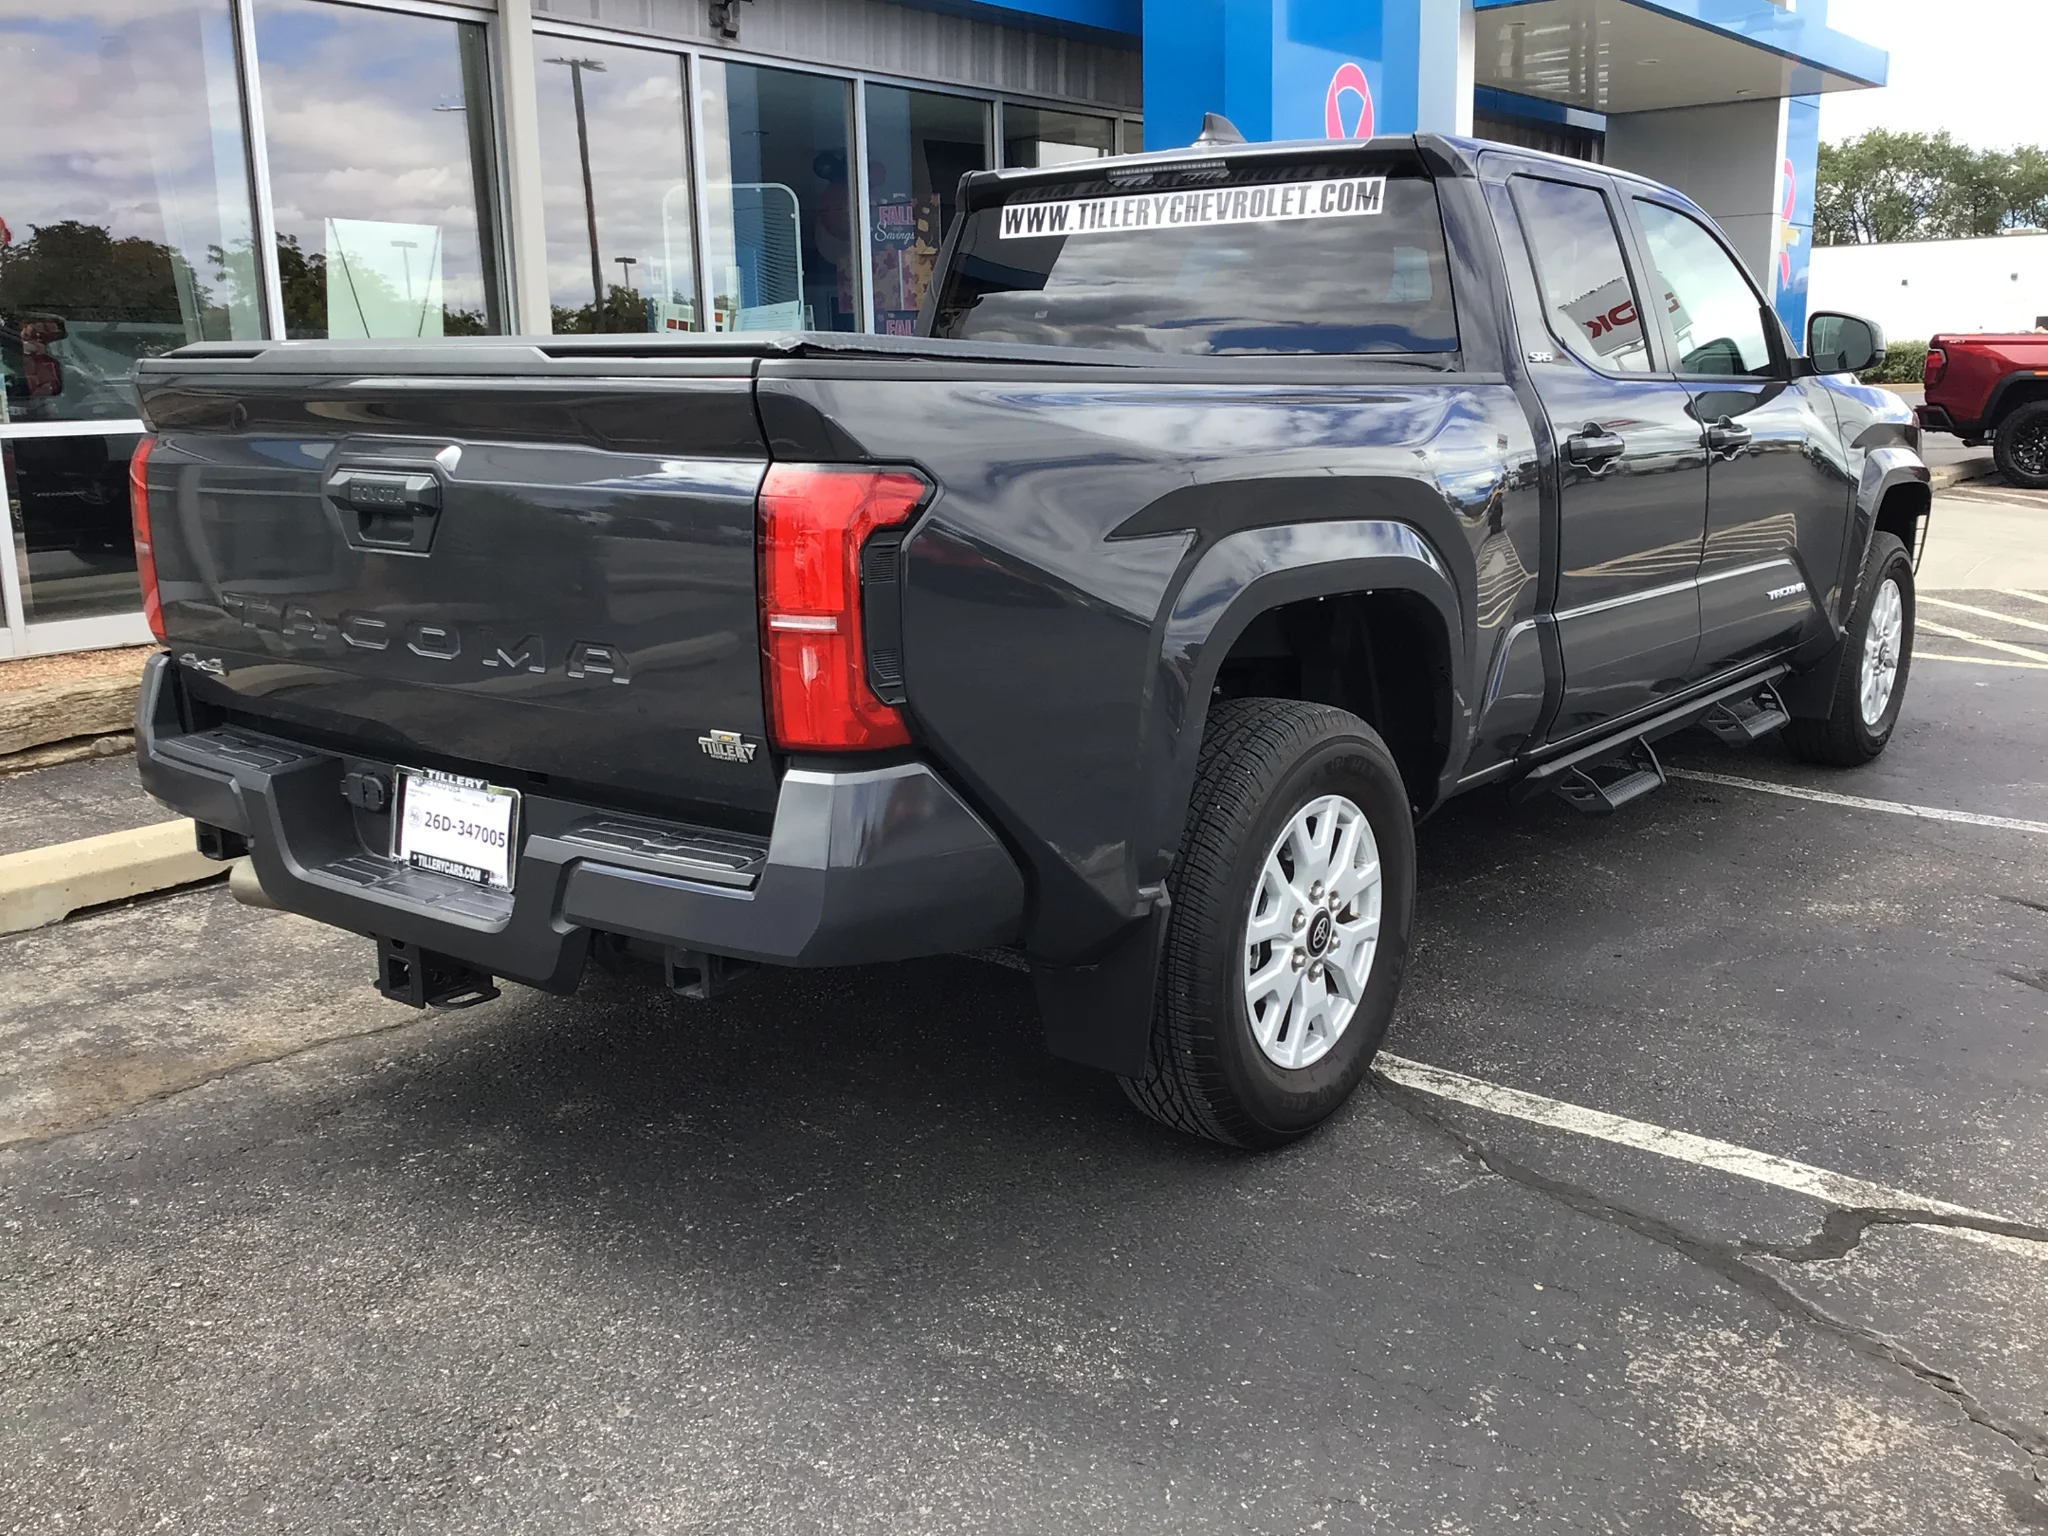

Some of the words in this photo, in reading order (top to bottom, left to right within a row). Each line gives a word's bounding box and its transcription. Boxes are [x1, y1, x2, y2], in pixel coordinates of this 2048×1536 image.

[878, 205, 916, 226] FALL
[1005, 180, 1381, 234] WWW.TILLERYCHEVROLET.COM
[874, 220, 915, 245] Savings
[886, 319, 916, 336] FAL
[351, 484, 404, 503] TOYOTA
[222, 591, 631, 684] TACOMA
[700, 741, 755, 760] TILLERY
[426, 770, 485, 790] TILLERY
[424, 811, 506, 848] 26D-347005
[418, 855, 482, 882] TILLERYCARS.COM
